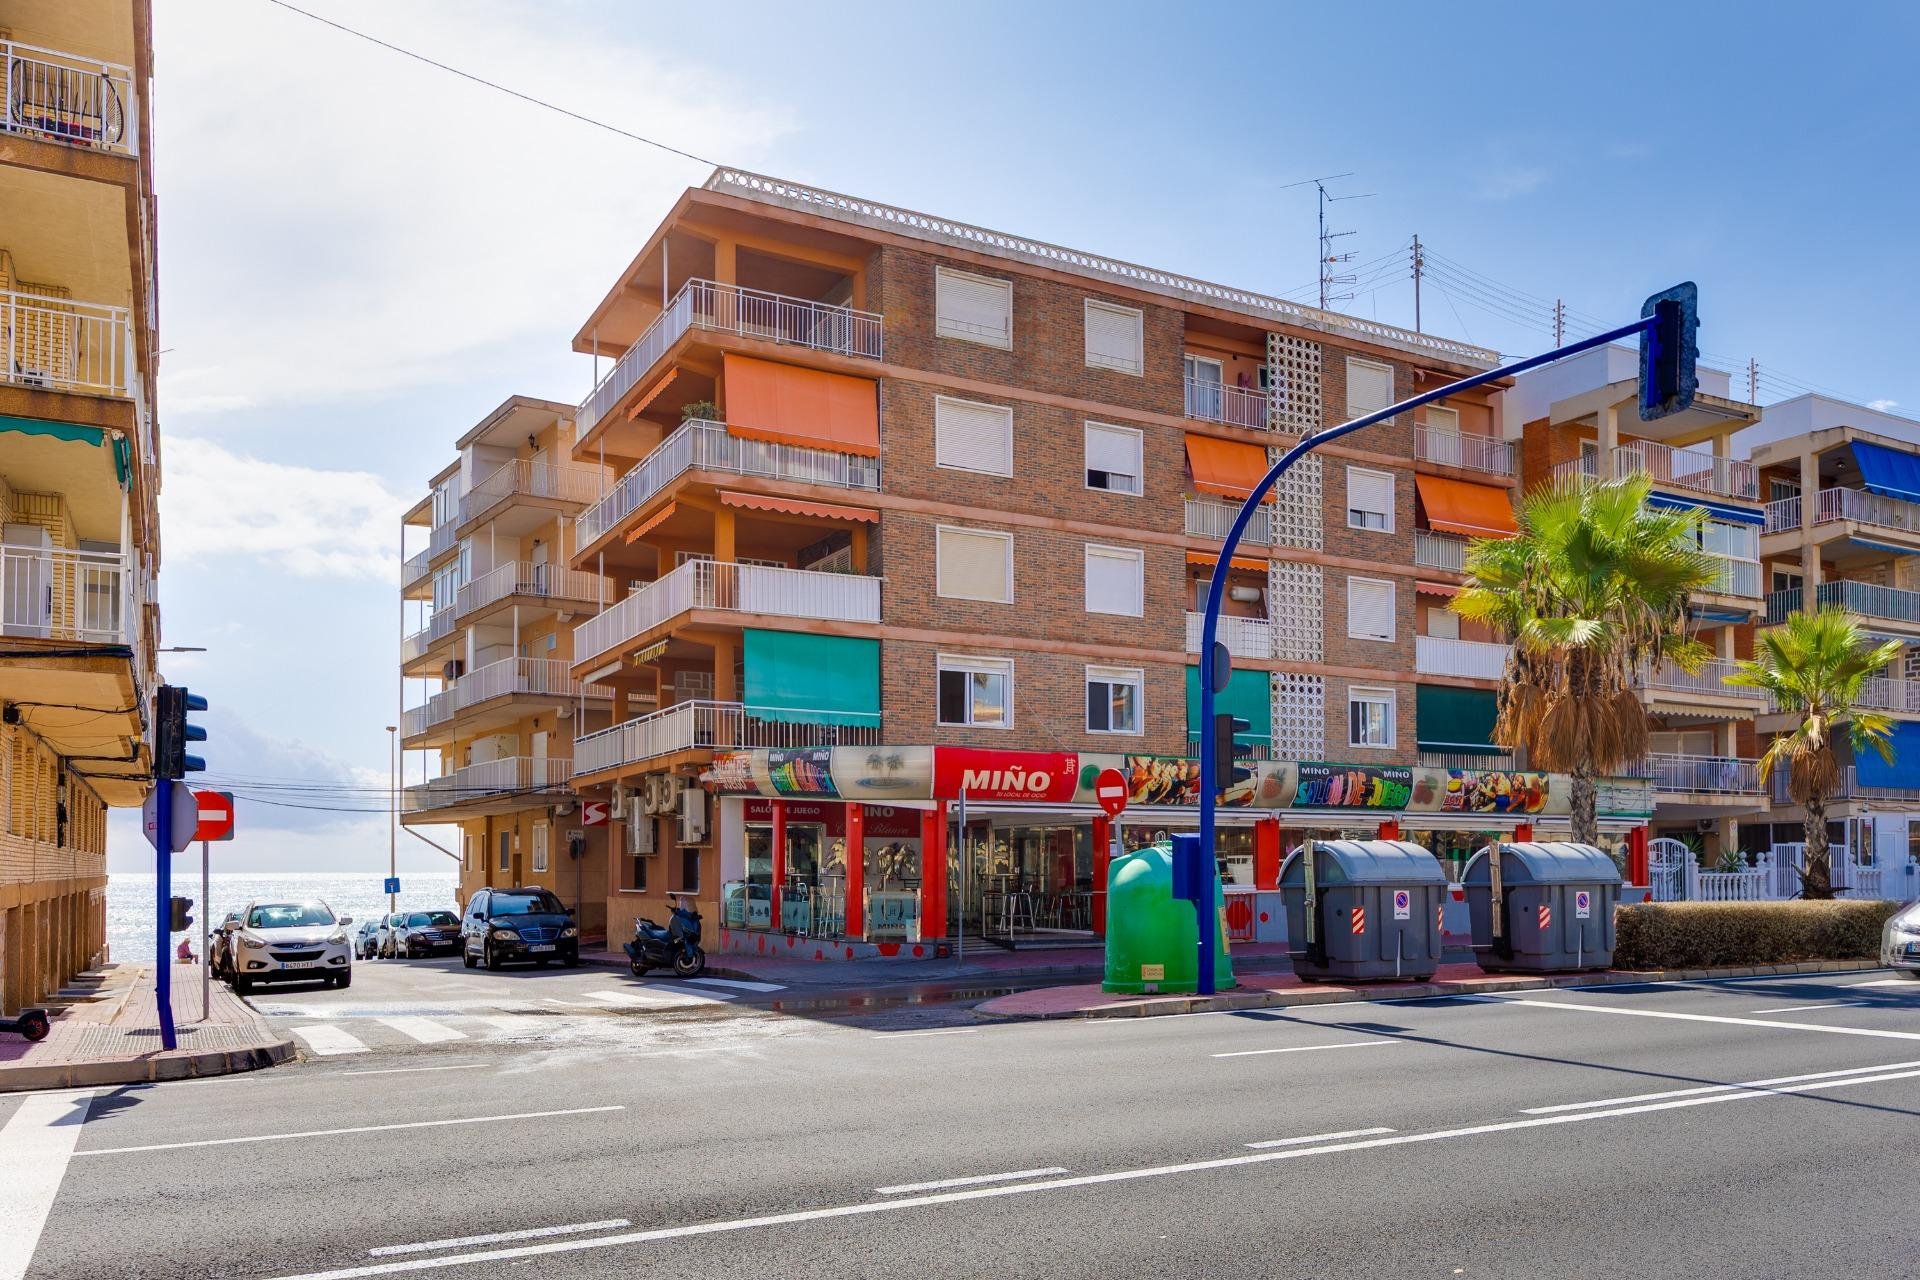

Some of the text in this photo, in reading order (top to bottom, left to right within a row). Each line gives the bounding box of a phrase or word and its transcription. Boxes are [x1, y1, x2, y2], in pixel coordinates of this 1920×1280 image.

[812, 750, 829, 761] MIÑO
[962, 765, 1051, 792] MIÑO
[1343, 771, 1367, 805] DE
[1367, 776, 1411, 806] JUEGO
[793, 807, 820, 815] JUEGO
